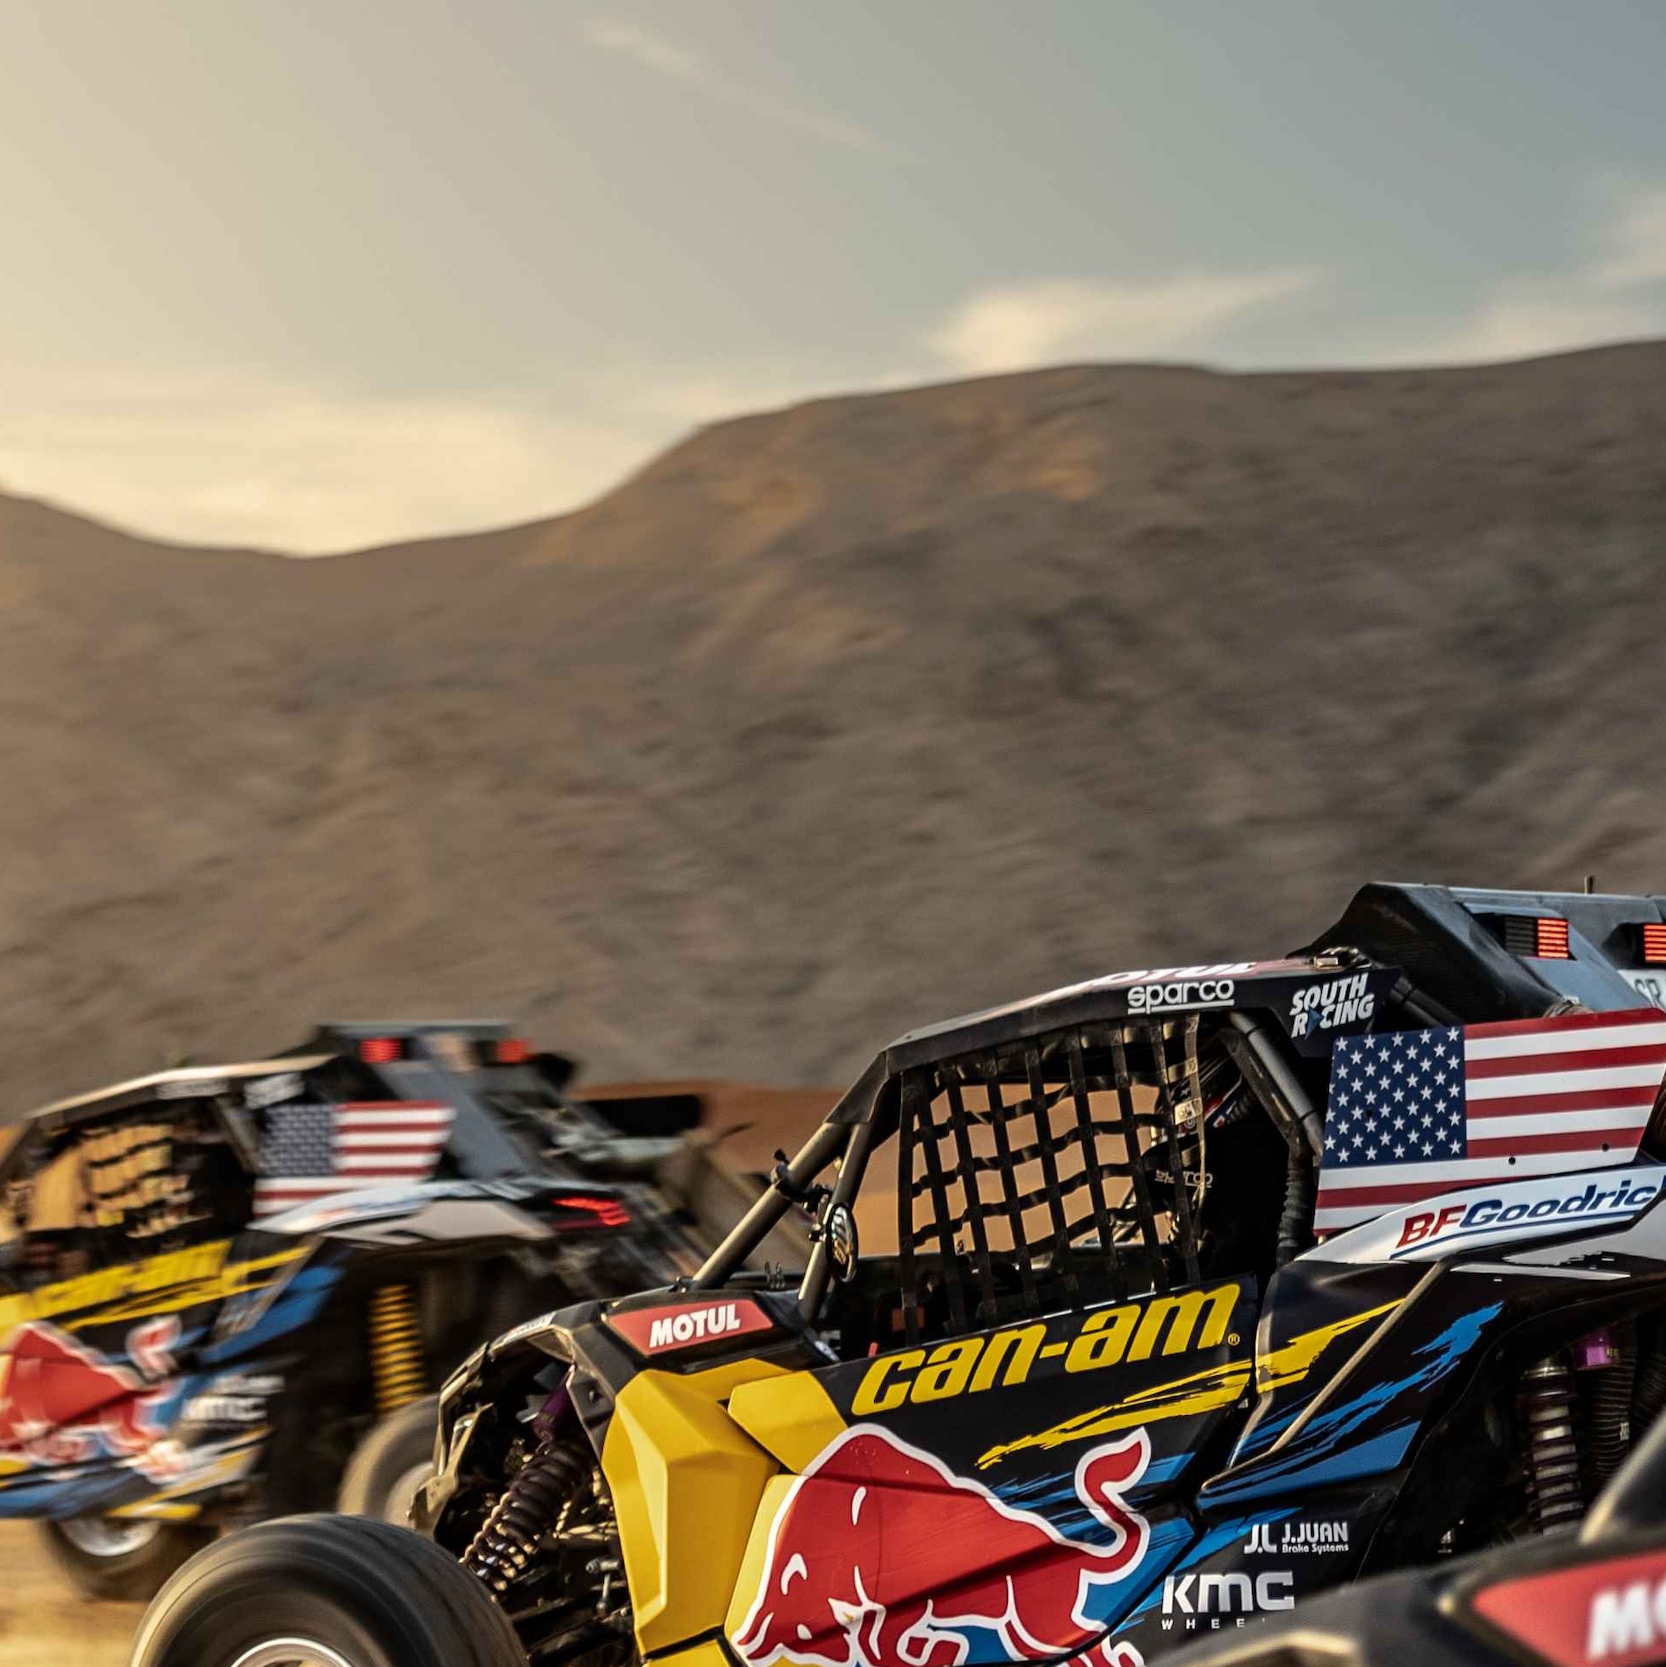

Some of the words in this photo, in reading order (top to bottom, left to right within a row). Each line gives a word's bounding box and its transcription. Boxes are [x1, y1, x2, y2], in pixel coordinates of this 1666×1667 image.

[1128, 979, 1234, 1014] sparco
[1289, 972, 1369, 1016] SOUTH
[649, 1303, 741, 1349] MOTUL
[851, 1284, 1241, 1416] can-am
[1281, 1522, 1349, 1543] J.JUAN
[1281, 1544, 1309, 1553] Brake
[1311, 1543, 1349, 1555] Systems
